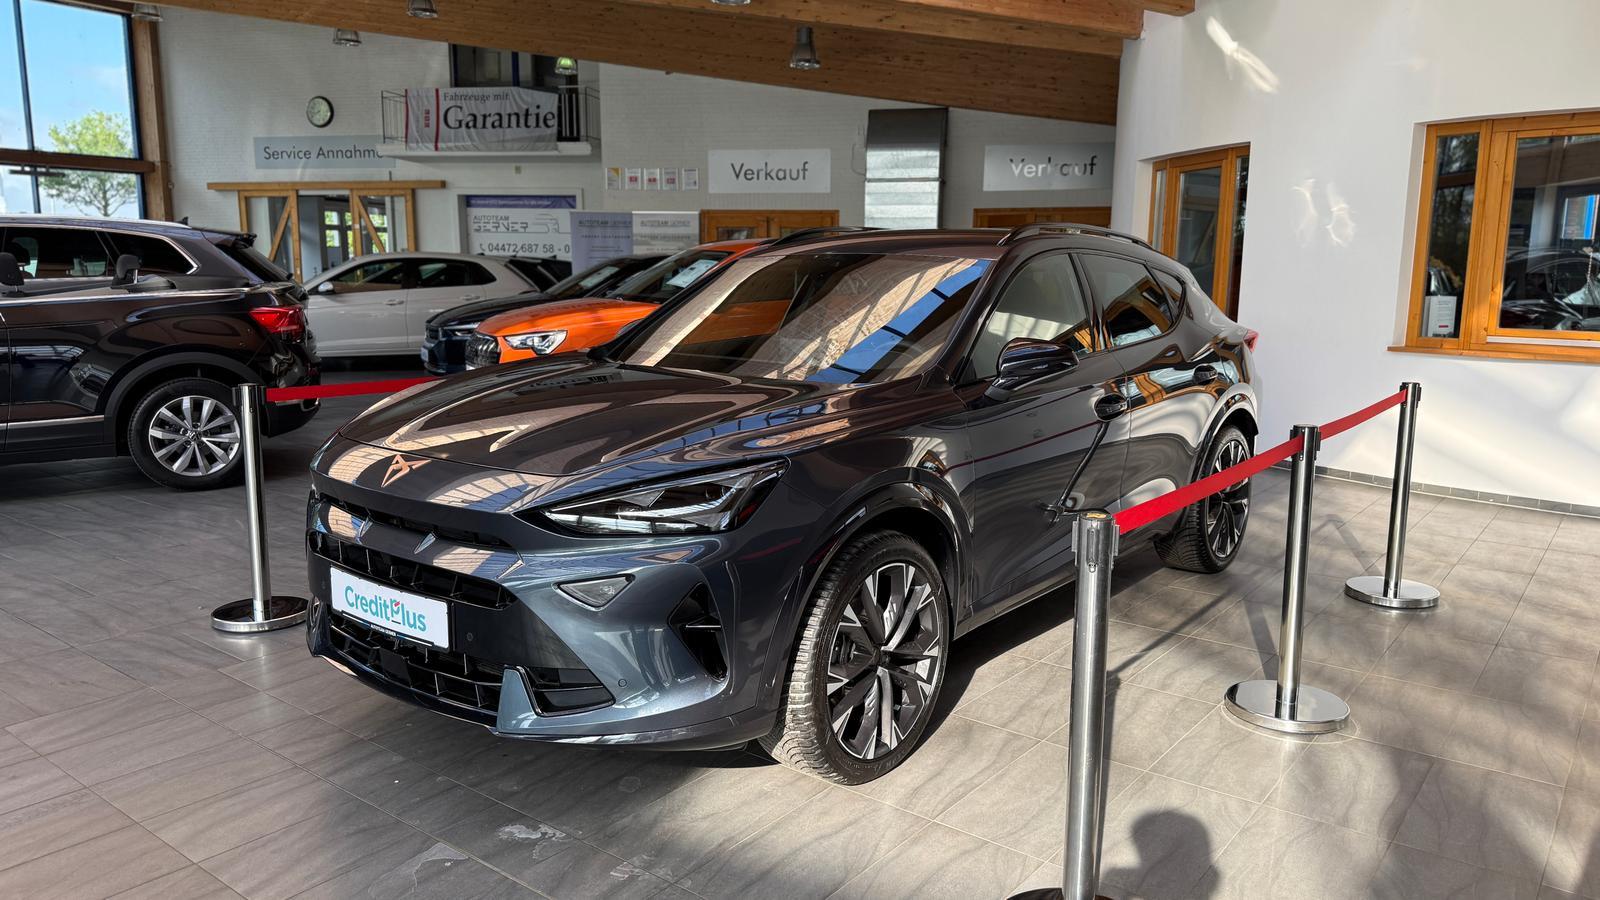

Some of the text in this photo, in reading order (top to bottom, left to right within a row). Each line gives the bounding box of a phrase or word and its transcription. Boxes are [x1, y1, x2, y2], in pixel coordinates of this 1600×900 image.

[443, 92, 510, 103] Fahrzeuge mit
[443, 104, 556, 130] Garantie
[263, 145, 312, 160] Service
[731, 161, 809, 181] Verkauf
[542, 244, 555, 254] 58
[345, 585, 427, 632] CreditPlus
